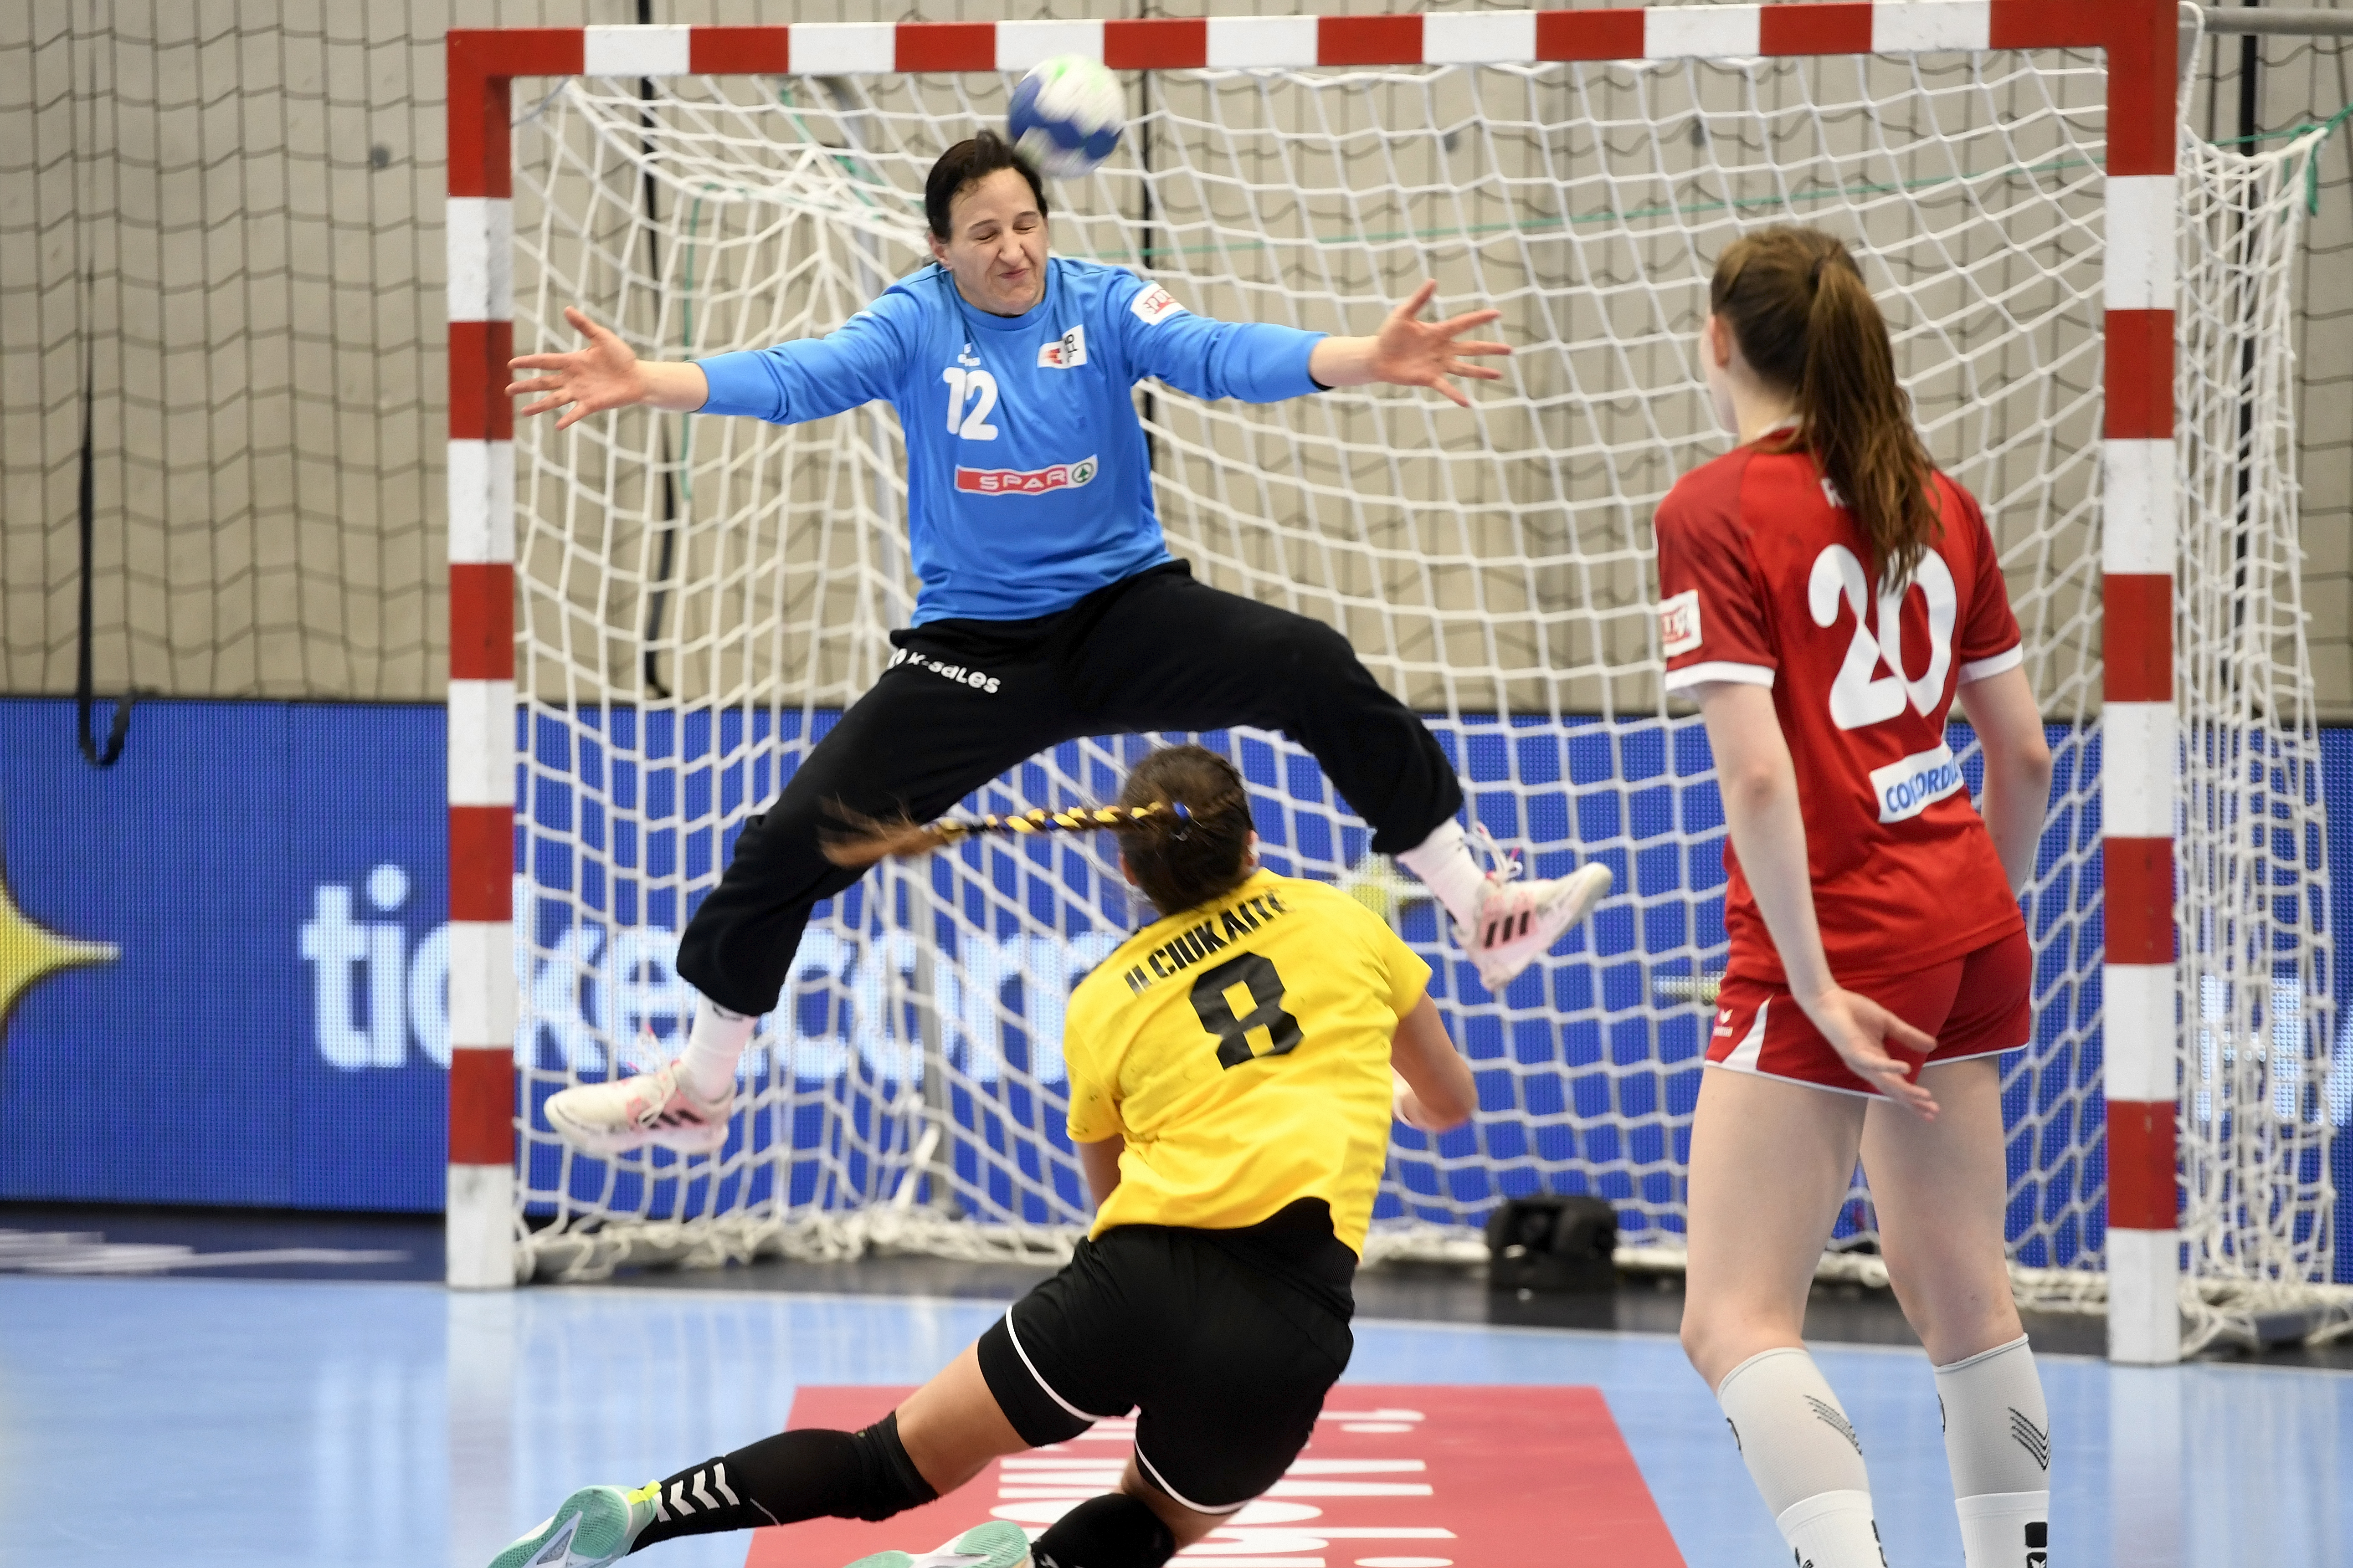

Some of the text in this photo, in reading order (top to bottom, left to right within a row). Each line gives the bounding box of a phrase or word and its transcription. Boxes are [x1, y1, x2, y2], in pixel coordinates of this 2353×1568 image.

[943, 367, 998, 441] 12
[979, 470, 1066, 490] SPAR
[1808, 543, 1957, 730] 20
[1189, 952, 1305, 1071] 8
